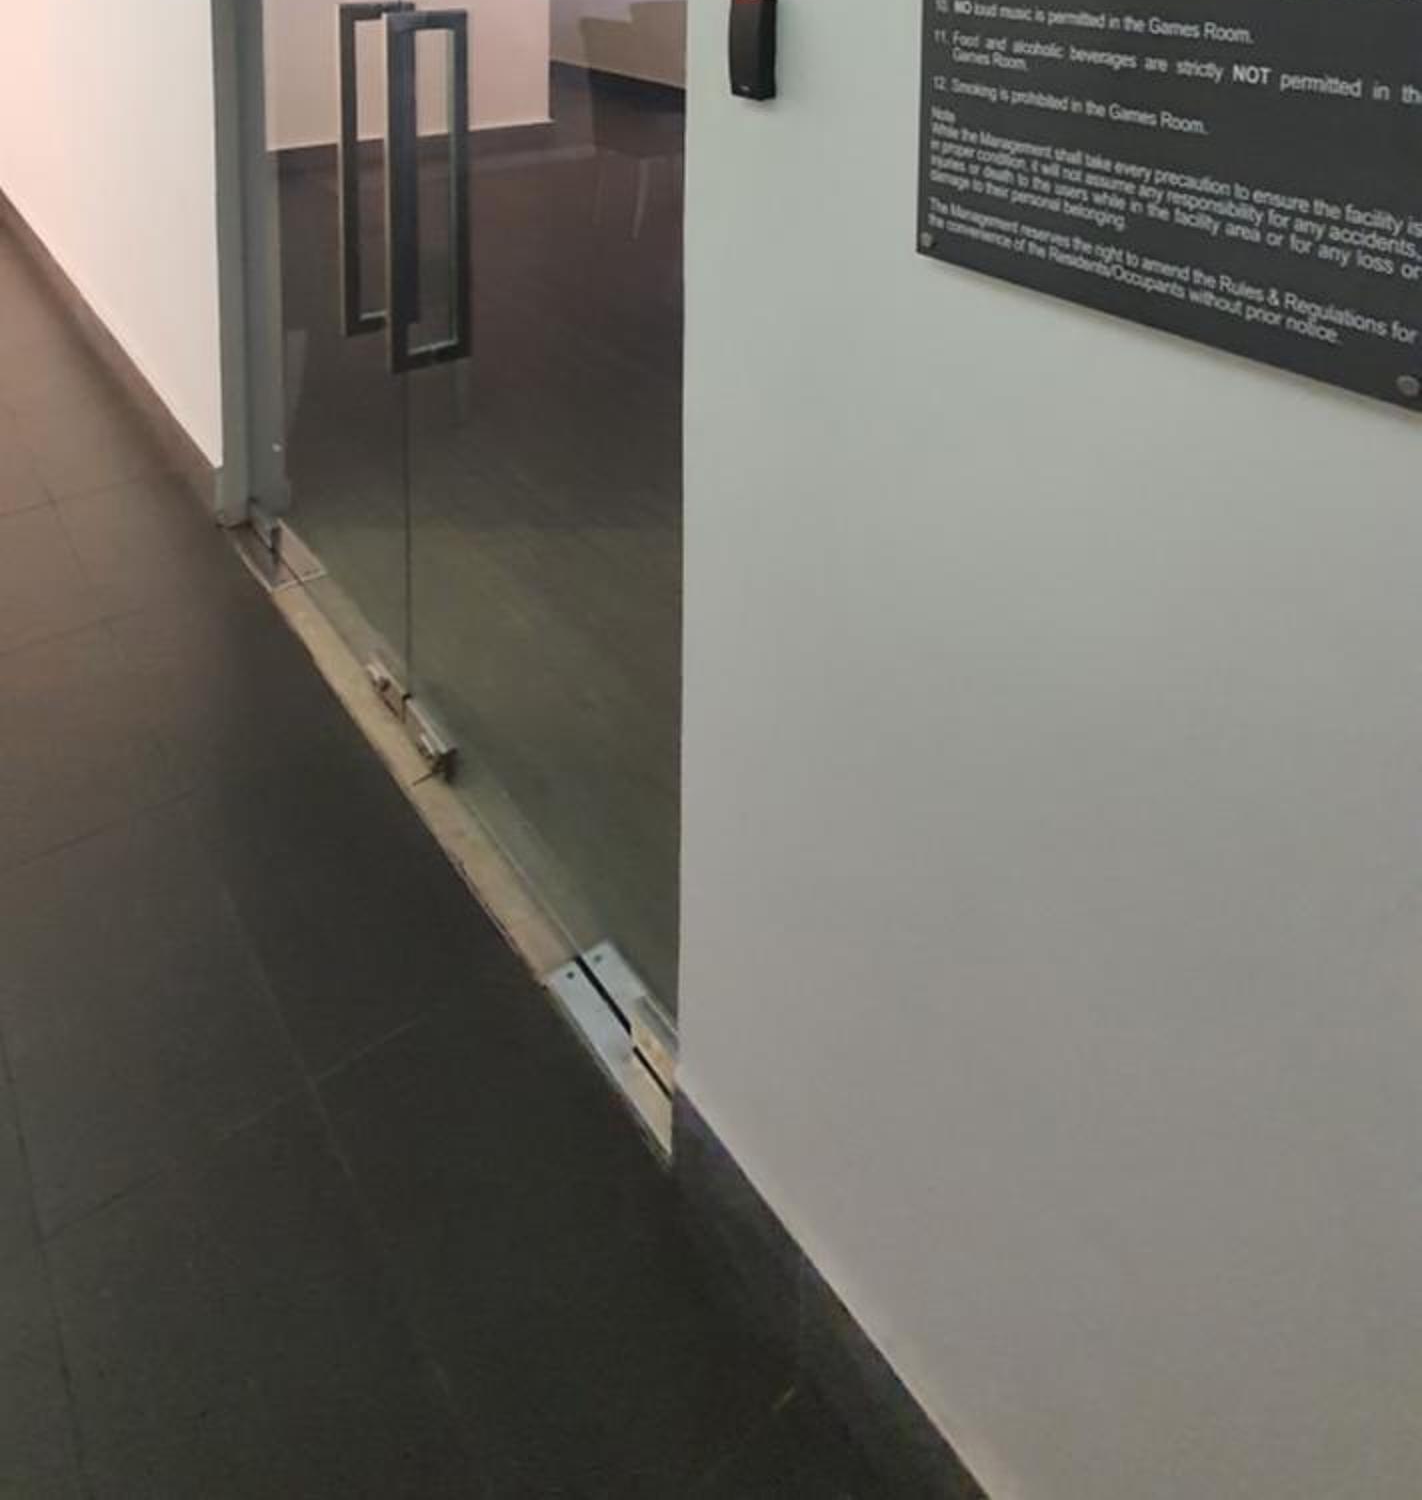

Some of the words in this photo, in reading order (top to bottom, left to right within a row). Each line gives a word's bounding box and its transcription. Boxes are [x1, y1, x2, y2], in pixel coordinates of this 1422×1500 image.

[1148, 16, 1201, 39] Games
[1144, 57, 1169, 73] are
[1176, 60, 1224, 83] strictly
[1232, 64, 1271, 85] NOT
[1279, 73, 1363, 98] permitted
[1372, 85, 1391, 101] in
[1138, 184, 1165, 204] any
[1267, 208, 1291, 229] for
[1293, 217, 1327, 240] any
[1233, 182, 1251, 201] to
[1252, 189, 1310, 214] ensure
[1313, 198, 1342, 220] the
[1345, 203, 1404, 236] facility
[1146, 201, 1170, 221] the
[1174, 207, 1221, 235] facility
[1224, 222, 1261, 243] area
[1289, 232, 1313, 254] for
[1317, 244, 1352, 266] any
[1356, 249, 1395, 275] loss
[1140, 257, 1191, 282] amend
[1192, 269, 1217, 289] the
[1219, 274, 1265, 303] Rules
[1266, 288, 1280, 307] &
[1284, 291, 1388, 337] Regulations
[1391, 320, 1419, 344] for
[1188, 289, 1243, 316] without
[1245, 305, 1284, 325] prior
